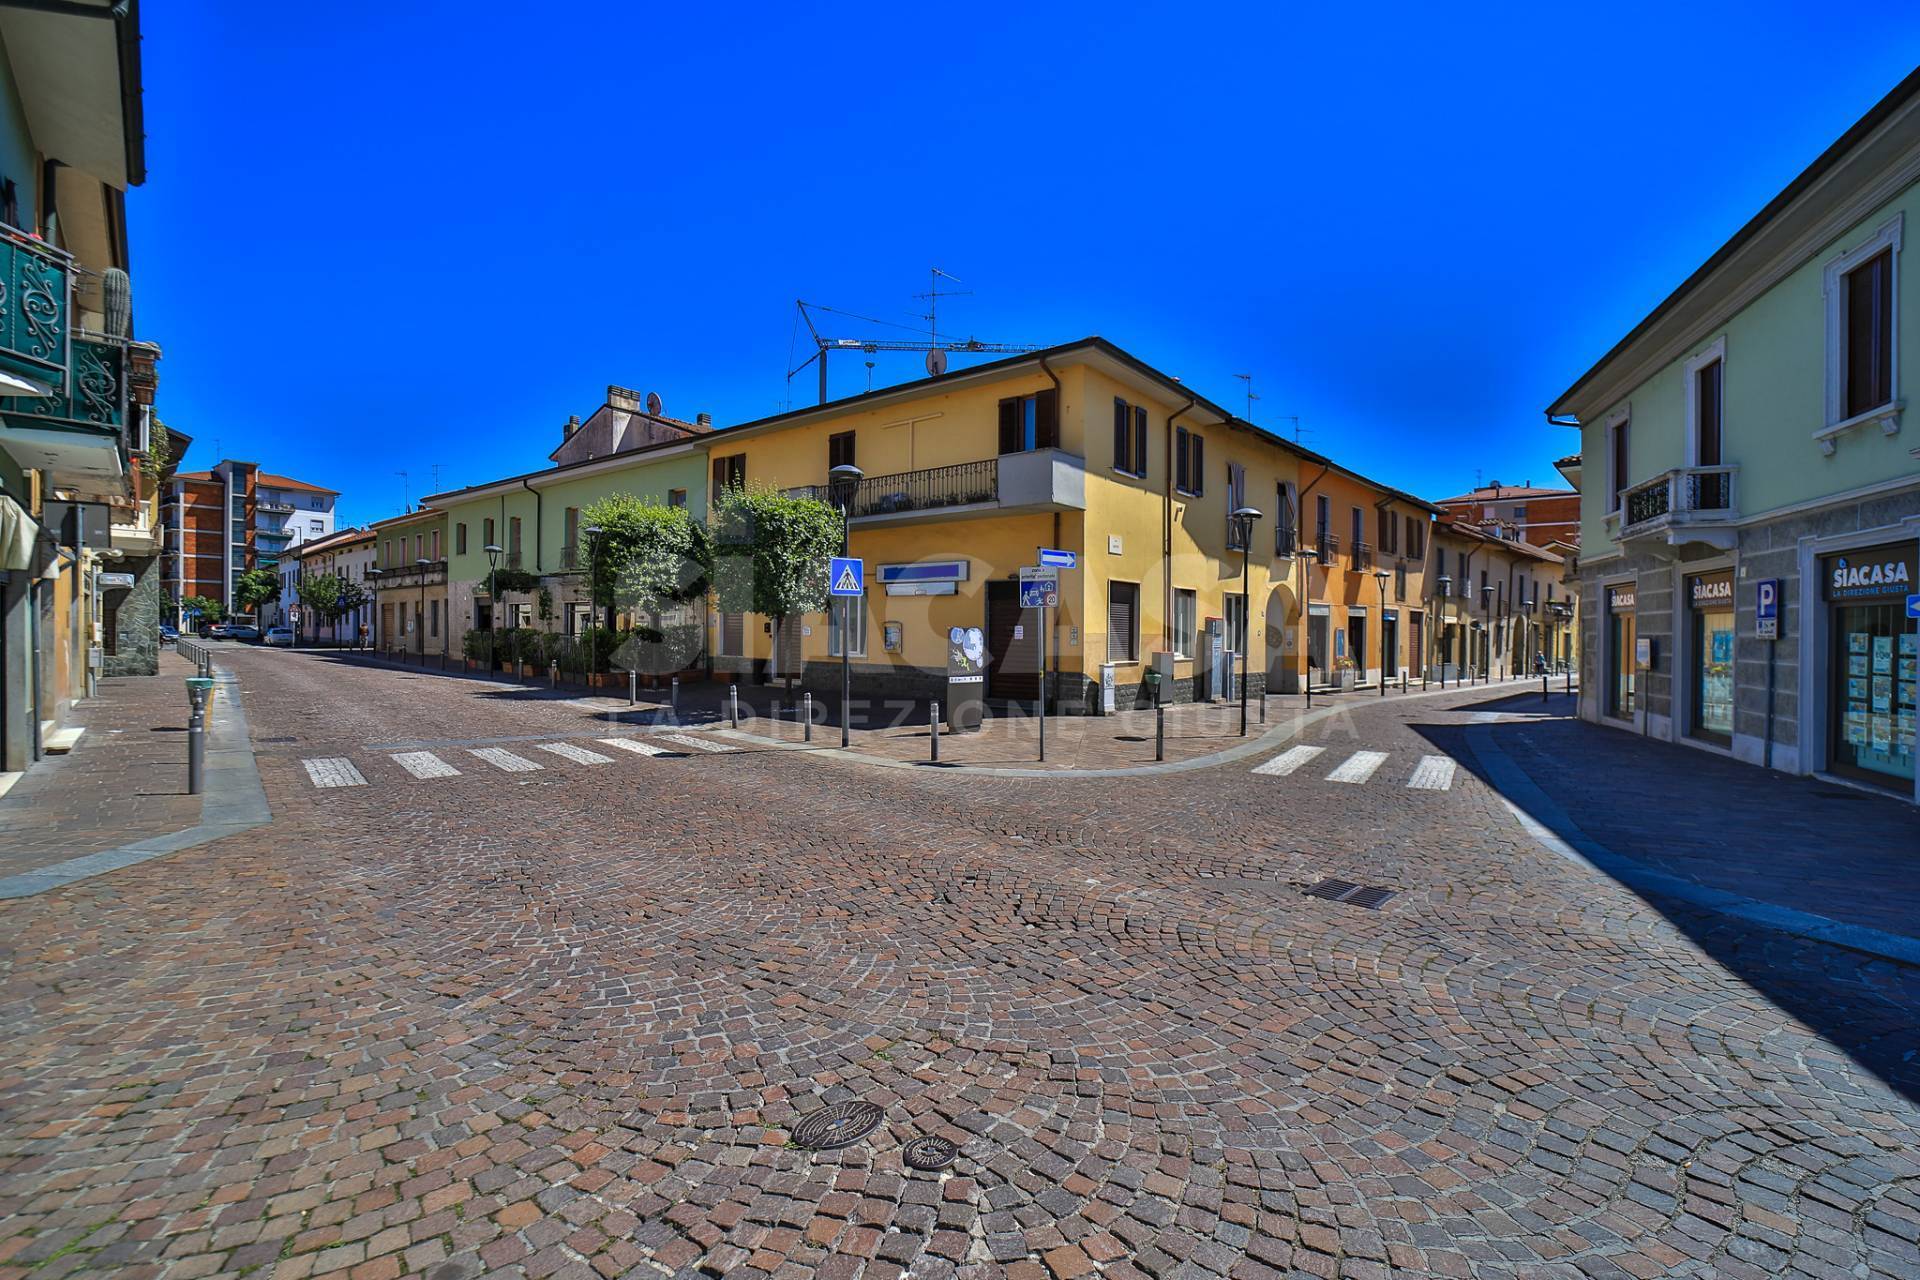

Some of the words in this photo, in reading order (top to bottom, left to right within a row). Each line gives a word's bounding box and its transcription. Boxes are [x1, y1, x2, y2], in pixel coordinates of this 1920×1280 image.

[1833, 561, 1909, 588] SIACASA
[1693, 582, 1732, 599] SIACASA
[1760, 584, 1774, 615] P
